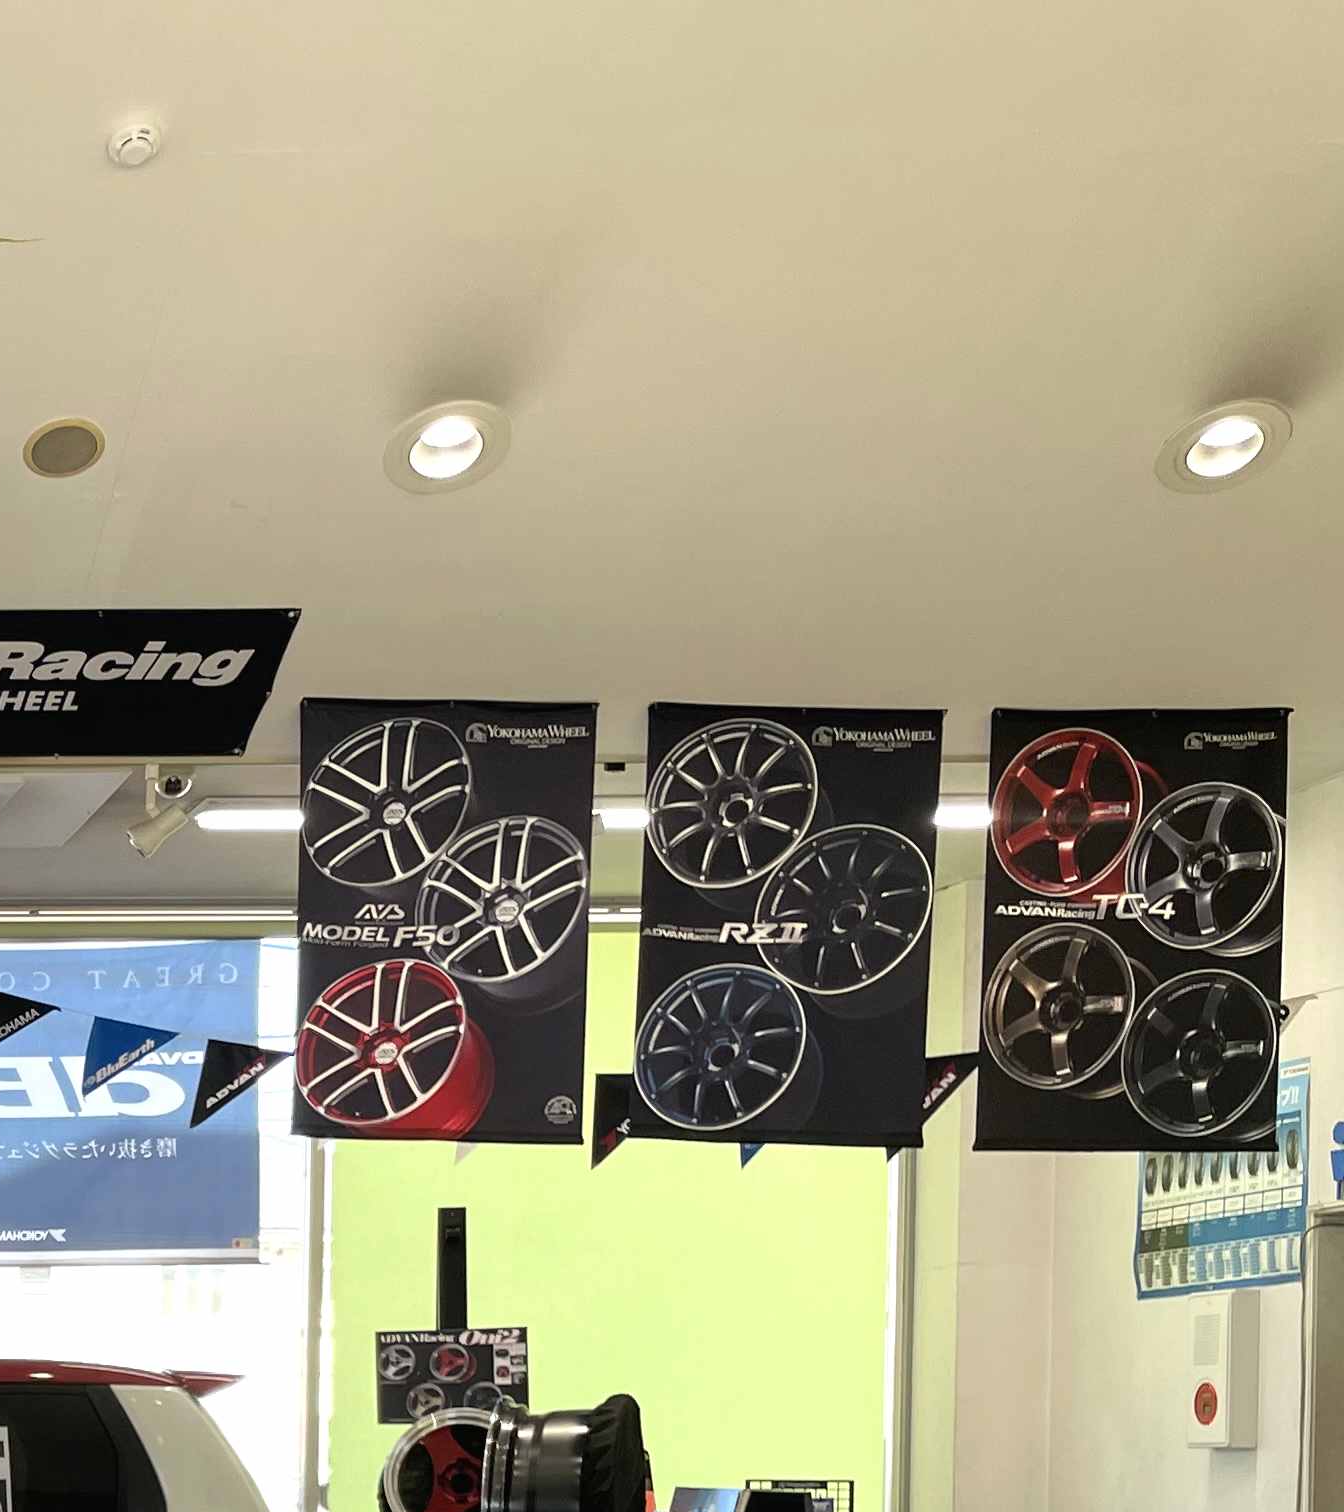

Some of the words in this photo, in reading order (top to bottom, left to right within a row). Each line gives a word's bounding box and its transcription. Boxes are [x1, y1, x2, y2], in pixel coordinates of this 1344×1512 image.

[994, 904, 1057, 918] ADVAN
[302, 922, 390, 944] MODEL
[393, 925, 460, 949] F50
[96, 1036, 155, 1084] BluEarth
[205, 1061, 265, 1110] ADVAN
